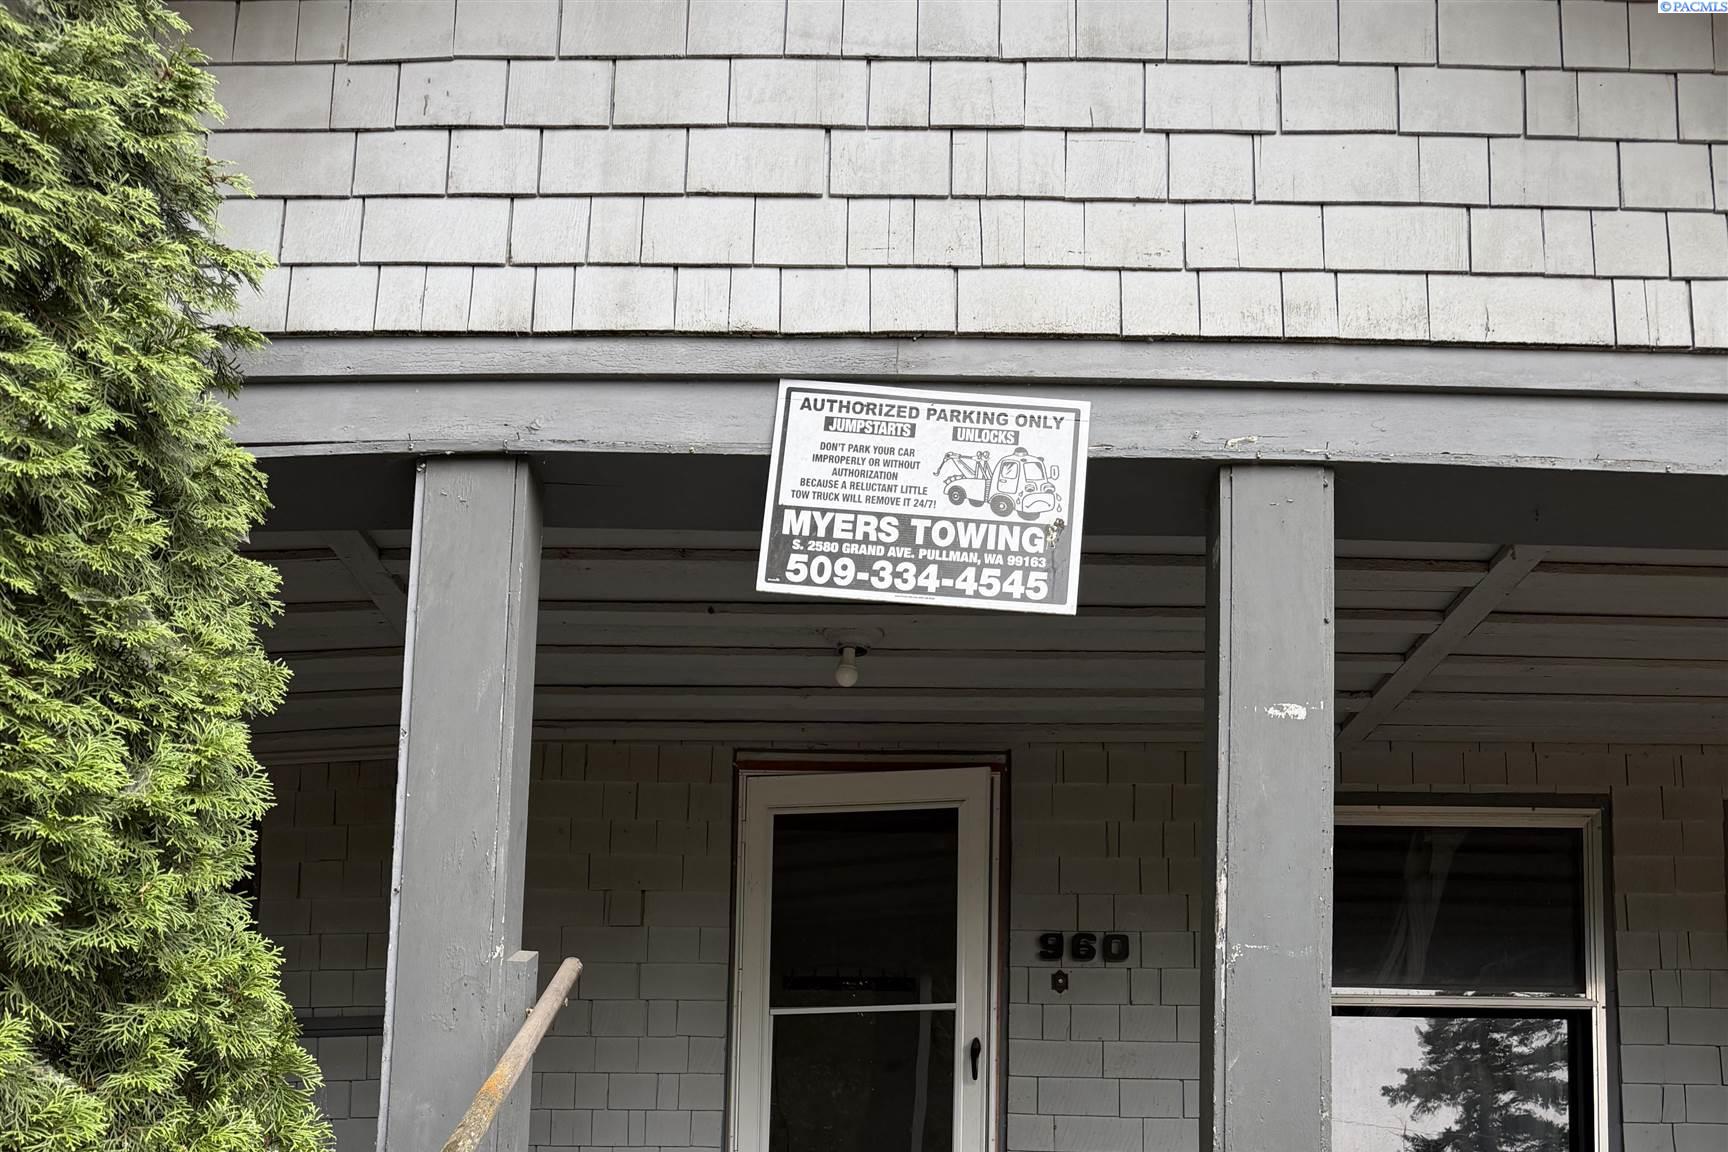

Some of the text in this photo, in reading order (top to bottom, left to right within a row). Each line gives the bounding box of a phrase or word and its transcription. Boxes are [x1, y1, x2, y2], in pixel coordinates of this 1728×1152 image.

[800, 397, 1065, 430] AUTHORIZED PARKING ONLY
[828, 417, 912, 437] JUMPSTARTS
[956, 428, 1016, 444] UNLOCKS
[820, 442, 915, 457] DON'T PARK YOUR CAR
[812, 454, 920, 470] IMPROPERLY OR WITHOUT
[831, 468, 898, 480] AUTHORIZATION
[800, 478, 928, 496] BECAUSE A RELUCTANT LITTLE
[791, 489, 936, 509] TOW TRUCK WILL REMOVE IT 24/7!
[782, 509, 1045, 553] MYERS TOWING
[791, 539, 1047, 568] S. 2580 GRAND AVE. PULLMAN, WA 99163
[785, 553, 1048, 600] 509-334-4545
[1037, 932, 1130, 963] 960
